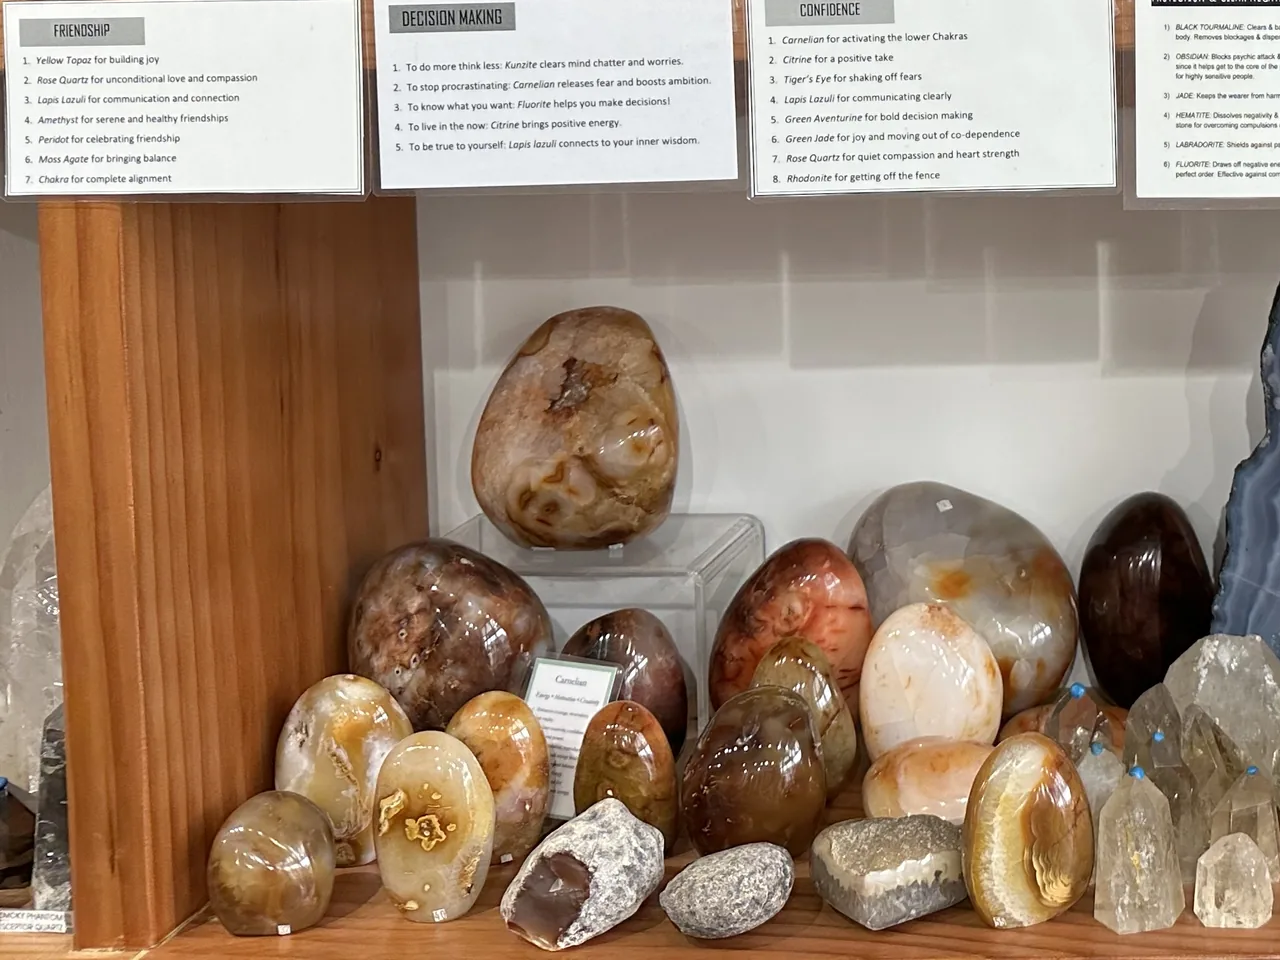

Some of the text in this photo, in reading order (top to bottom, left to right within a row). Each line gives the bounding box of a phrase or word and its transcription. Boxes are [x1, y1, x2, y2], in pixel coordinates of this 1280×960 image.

[800, 2, 861, 17] CONFIDENCE
[402, 8, 503, 27] DECISION MAKING
[54, 23, 110, 38] FRIENDSHIP
[768, 32, 968, 45] 1. Carnelian for activating the lower Chakras
[23, 57, 31, 66] 1.
[36, 56, 64, 65] Yellow
[66, 56, 92, 67] Topaz
[94, 55, 107, 65] for
[109, 55, 145, 66] building
[393, 63, 401, 73] 1.
[405, 63, 418, 72] To
[419, 62, 431, 72] do
[433, 64, 457, 72] more
[458, 61, 481, 71] think
[504, 61, 538, 70] Kunzite
[539, 60, 566, 69] clears
[568, 59, 591, 69] mind
[593, 58, 626, 68] chatter
[627, 57, 645, 67] and
[769, 56, 777, 65] 2.
[783, 55, 812, 65] Citrine
[814, 54, 828, 64] for
[837, 55, 872, 65] positive
[874, 53, 894, 62] take
[24, 74, 258, 85] 2. Rose Quartz for unconditional love and compassion
[769, 72, 923, 86] 3. Tiger's Eye for shaking off fears
[1163, 92, 1170, 101] 3)
[1196, 92, 1216, 101] Keeps
[1250, 92, 1265, 100] from
[394, 123, 403, 132] 4.
[408, 122, 420, 132] To
[421, 122, 437, 132] live
[449, 121, 465, 131] the
[490, 120, 520, 130] Citrine
[521, 120, 549, 131] brings
[551, 120, 587, 130] positive
[25, 174, 172, 185] 7. Chakra for complete alignment
